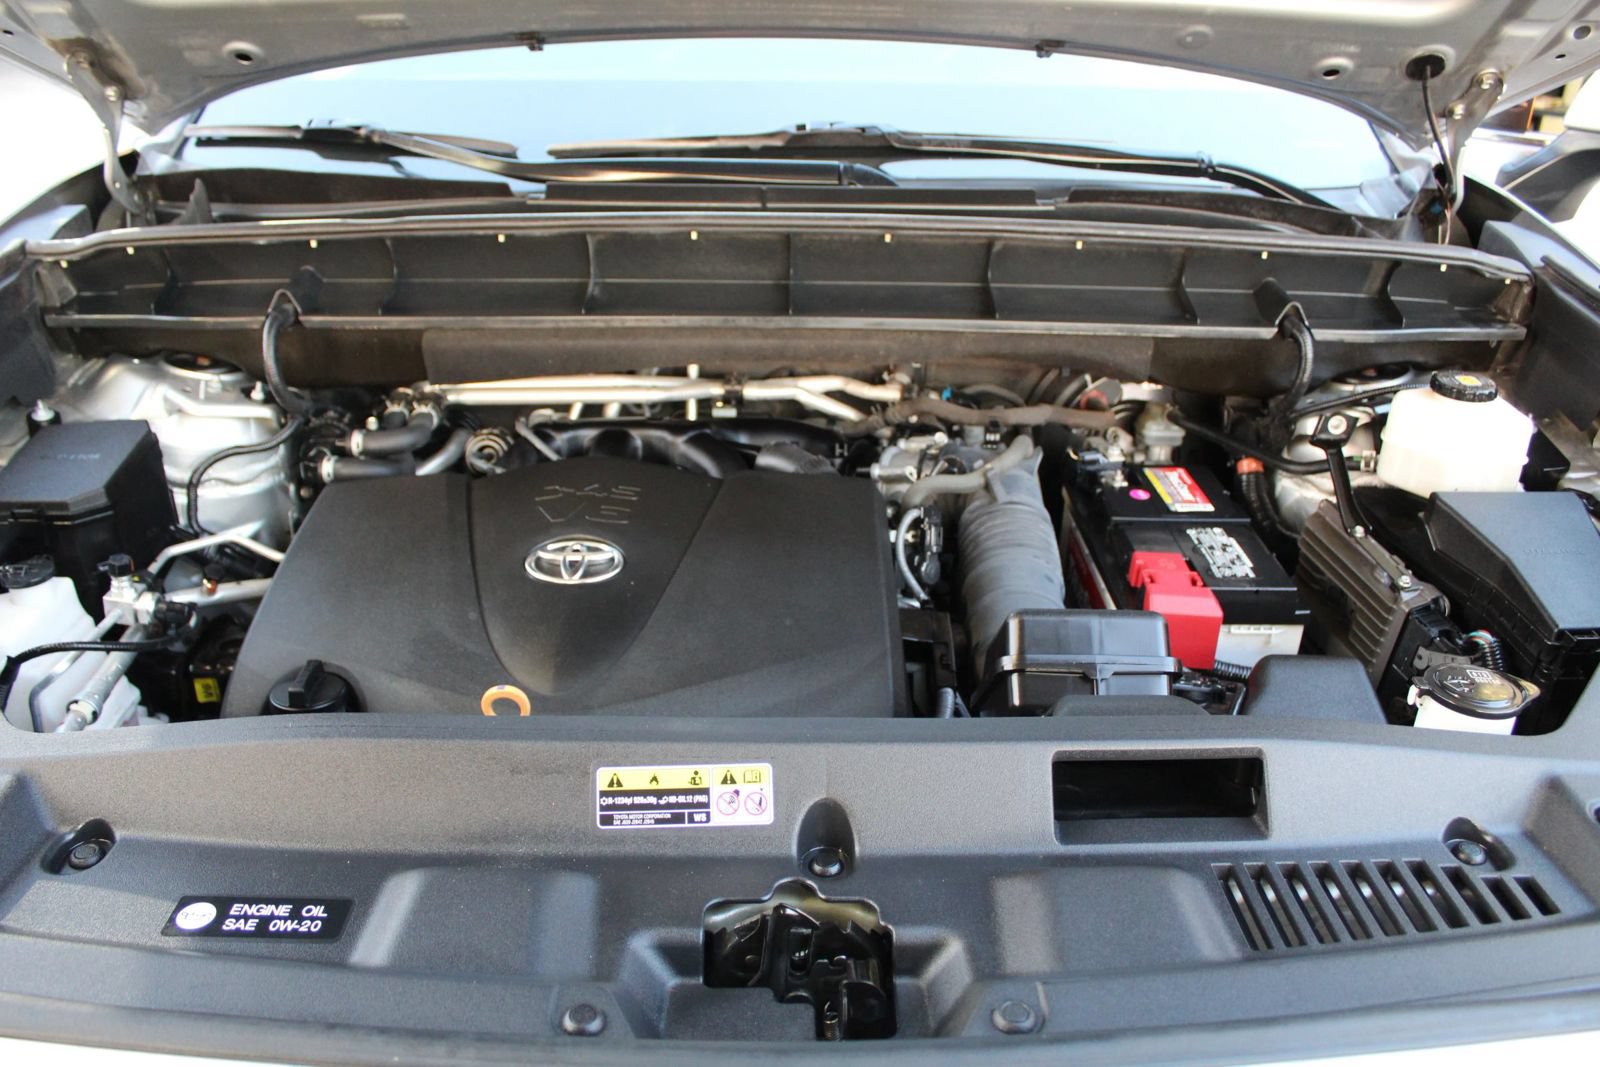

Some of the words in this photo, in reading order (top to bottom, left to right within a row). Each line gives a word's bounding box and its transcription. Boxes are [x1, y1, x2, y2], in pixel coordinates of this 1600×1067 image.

[693, 813, 707, 822] WS
[229, 903, 293, 917] ENGINE
[301, 904, 328, 917] OIL
[222, 918, 259, 932] SAE
[268, 919, 323, 932] 0W-20
